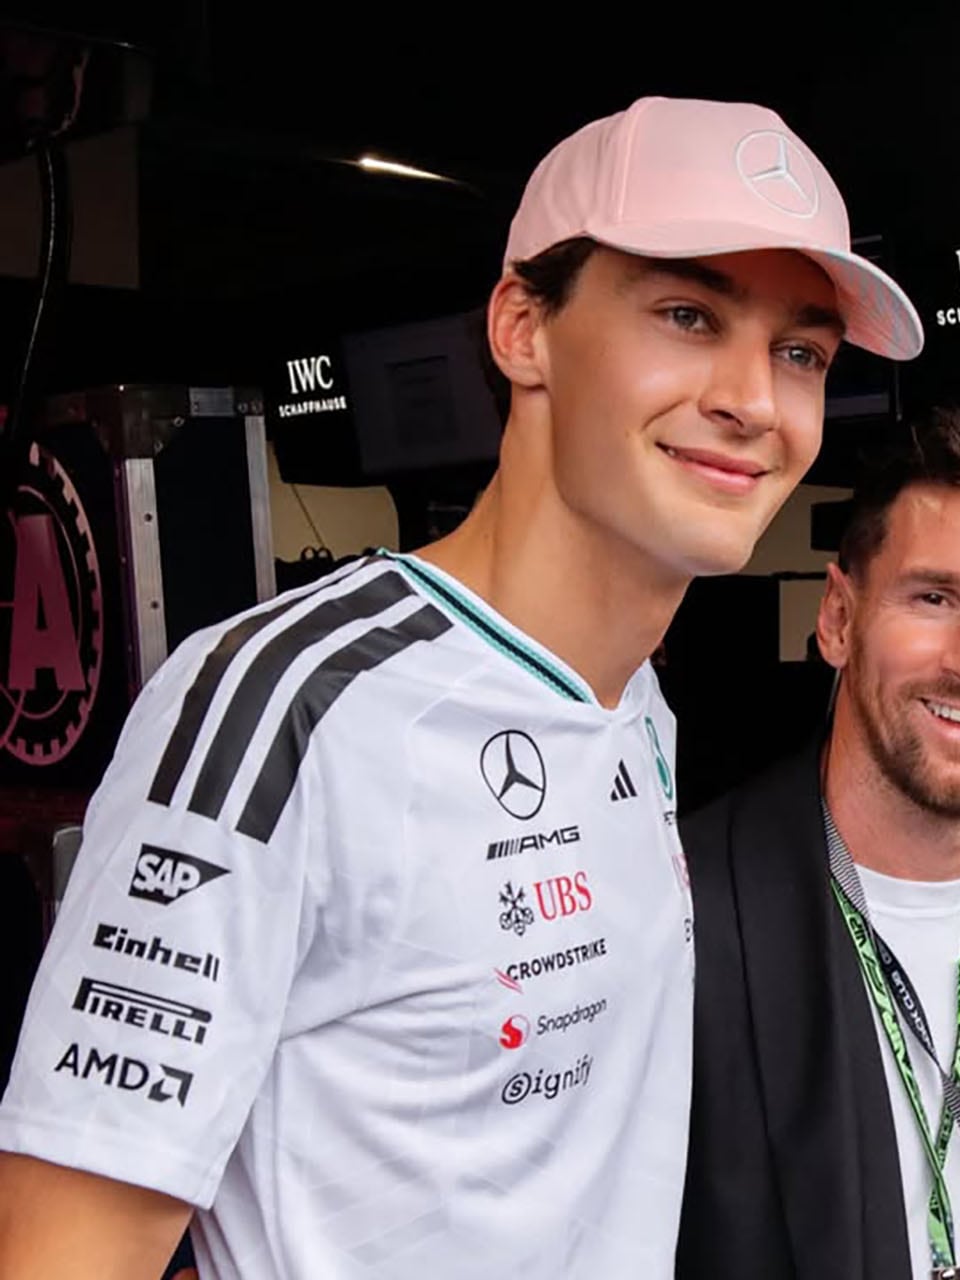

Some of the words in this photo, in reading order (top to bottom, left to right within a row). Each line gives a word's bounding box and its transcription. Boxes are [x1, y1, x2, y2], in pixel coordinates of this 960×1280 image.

[286, 355, 334, 395] IWC
[518, 825, 581, 855] AMG
[131, 851, 204, 899] SAP
[534, 870, 593, 922] UBS
[92, 922, 220, 983] Einhell
[849, 916, 868, 948] VIP
[507, 938, 607, 983] CROWDSTRIKE
[71, 976, 213, 1046] PIRELLI
[891, 970, 914, 1010] CLUB
[536, 998, 607, 1036] Snapdragon
[54, 1042, 150, 1092] AMD
[501, 1054, 593, 1106] signify
